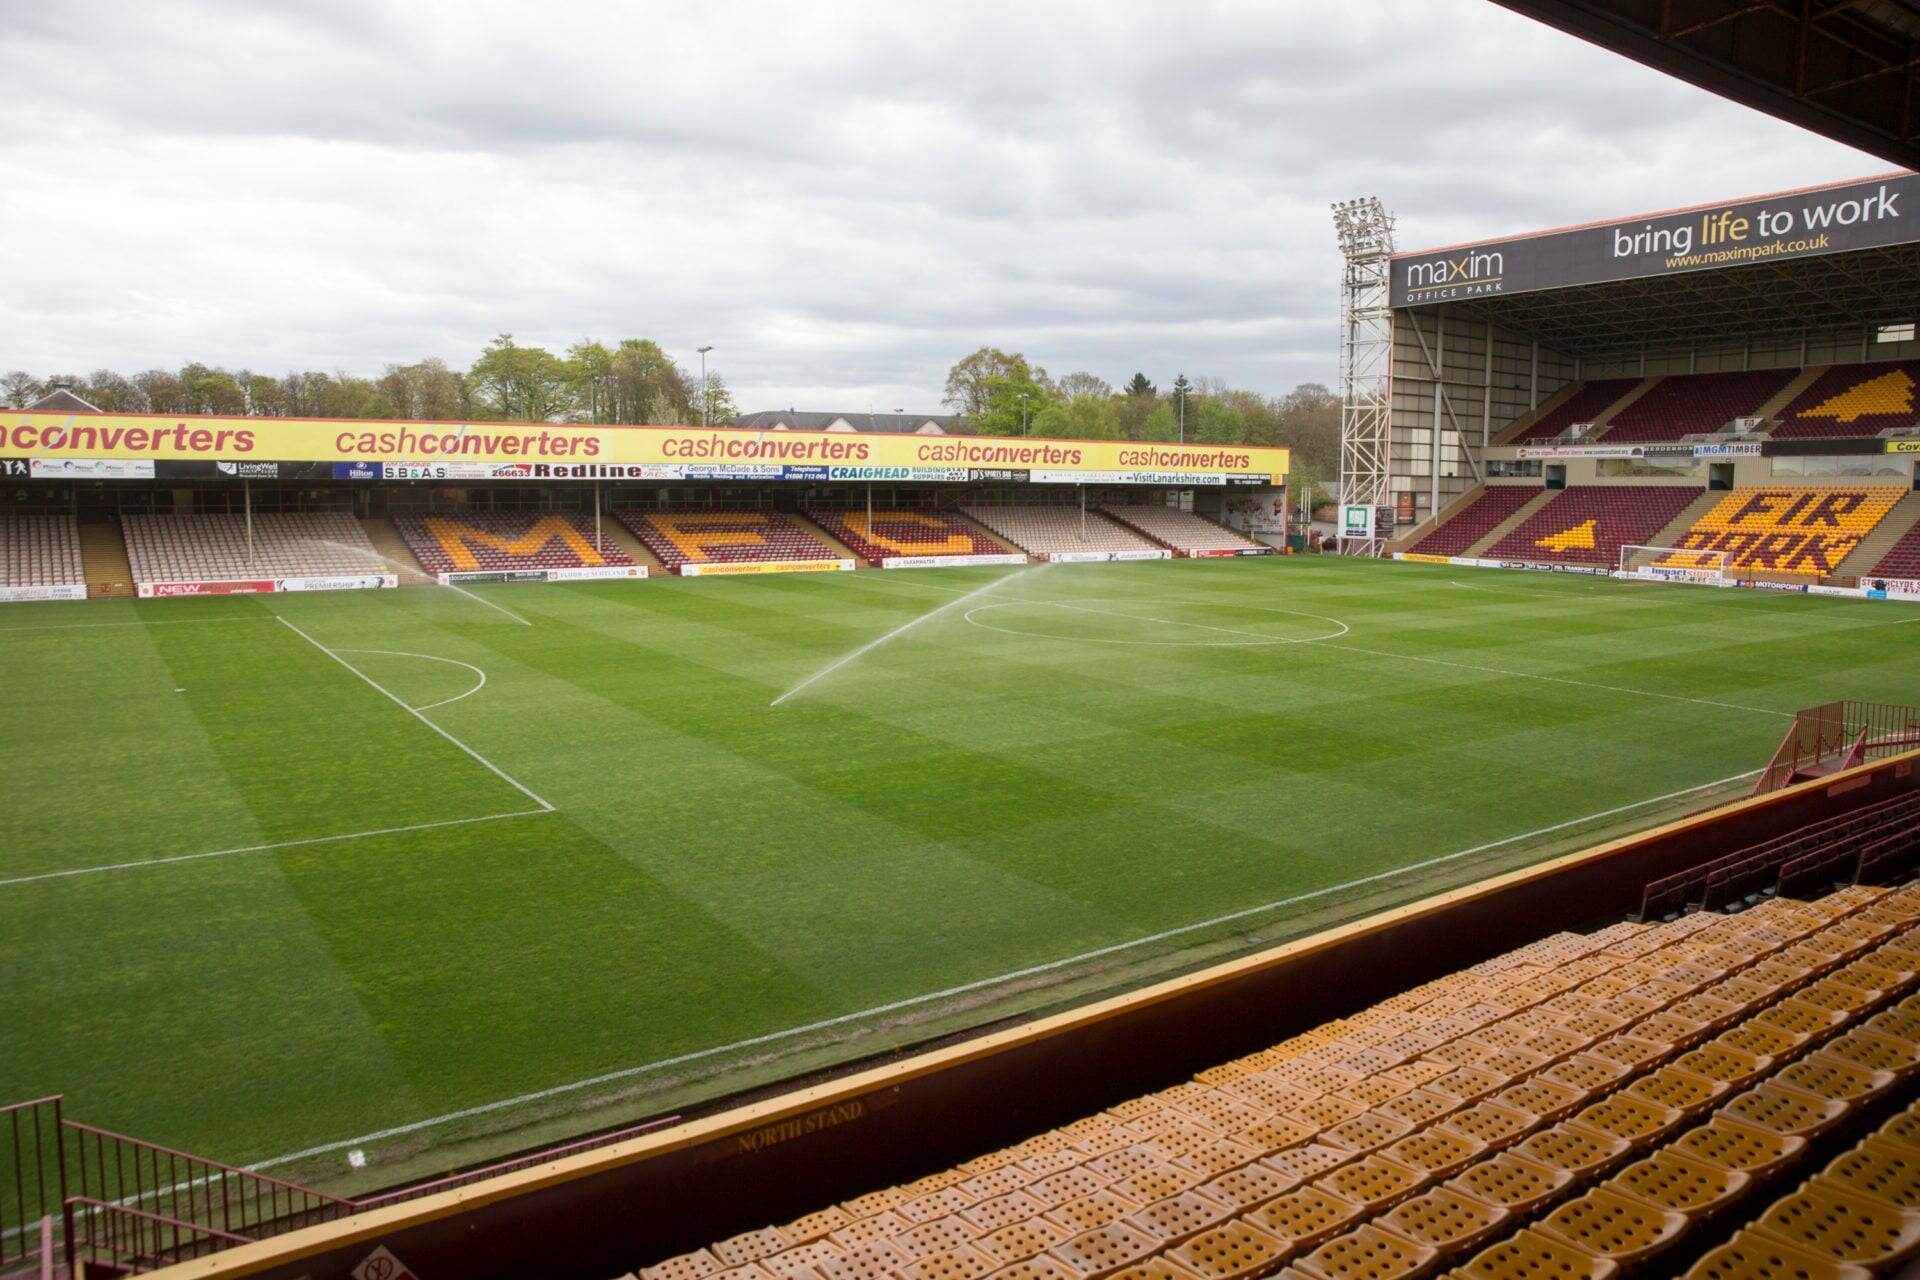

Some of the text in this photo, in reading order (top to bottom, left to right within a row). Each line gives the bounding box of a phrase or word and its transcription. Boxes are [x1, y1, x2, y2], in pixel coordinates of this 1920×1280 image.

[1614, 186, 1900, 257] bring life to work
[1665, 233, 1829, 269] www.maximpark.co.uk
[1407, 250, 1503, 287] maxim
[1407, 283, 1503, 302] OFFICE PARK
[335, 427, 600, 456] cashconverters
[662, 434, 869, 460] cashconverters
[917, 440, 1082, 465] cashconverters
[1118, 447, 1250, 468] cashconverters
[238, 462, 278, 472] LivingWell
[349, 469, 374, 478] Hilton
[534, 464, 642, 477] Redline
[687, 464, 717, 474] George
[720, 465, 751, 473] McDade
[753, 465, 759, 473] &
[831, 467, 910, 479] CRAIGHEAD
[1133, 472, 1220, 484] VisitLanarkshire.com
[1727, 492, 1868, 527] FIR
[1652, 531, 1865, 576] PARK
[702, 563, 762, 573] cashconverters
[775, 561, 832, 570] cashconverters
[159, 584, 201, 593] NEW
[304, 582, 355, 590] PREMIERSHIP
[1755, 581, 1803, 592] MOTORPOINT
[738, 1100, 863, 1155] NORTH STAND
